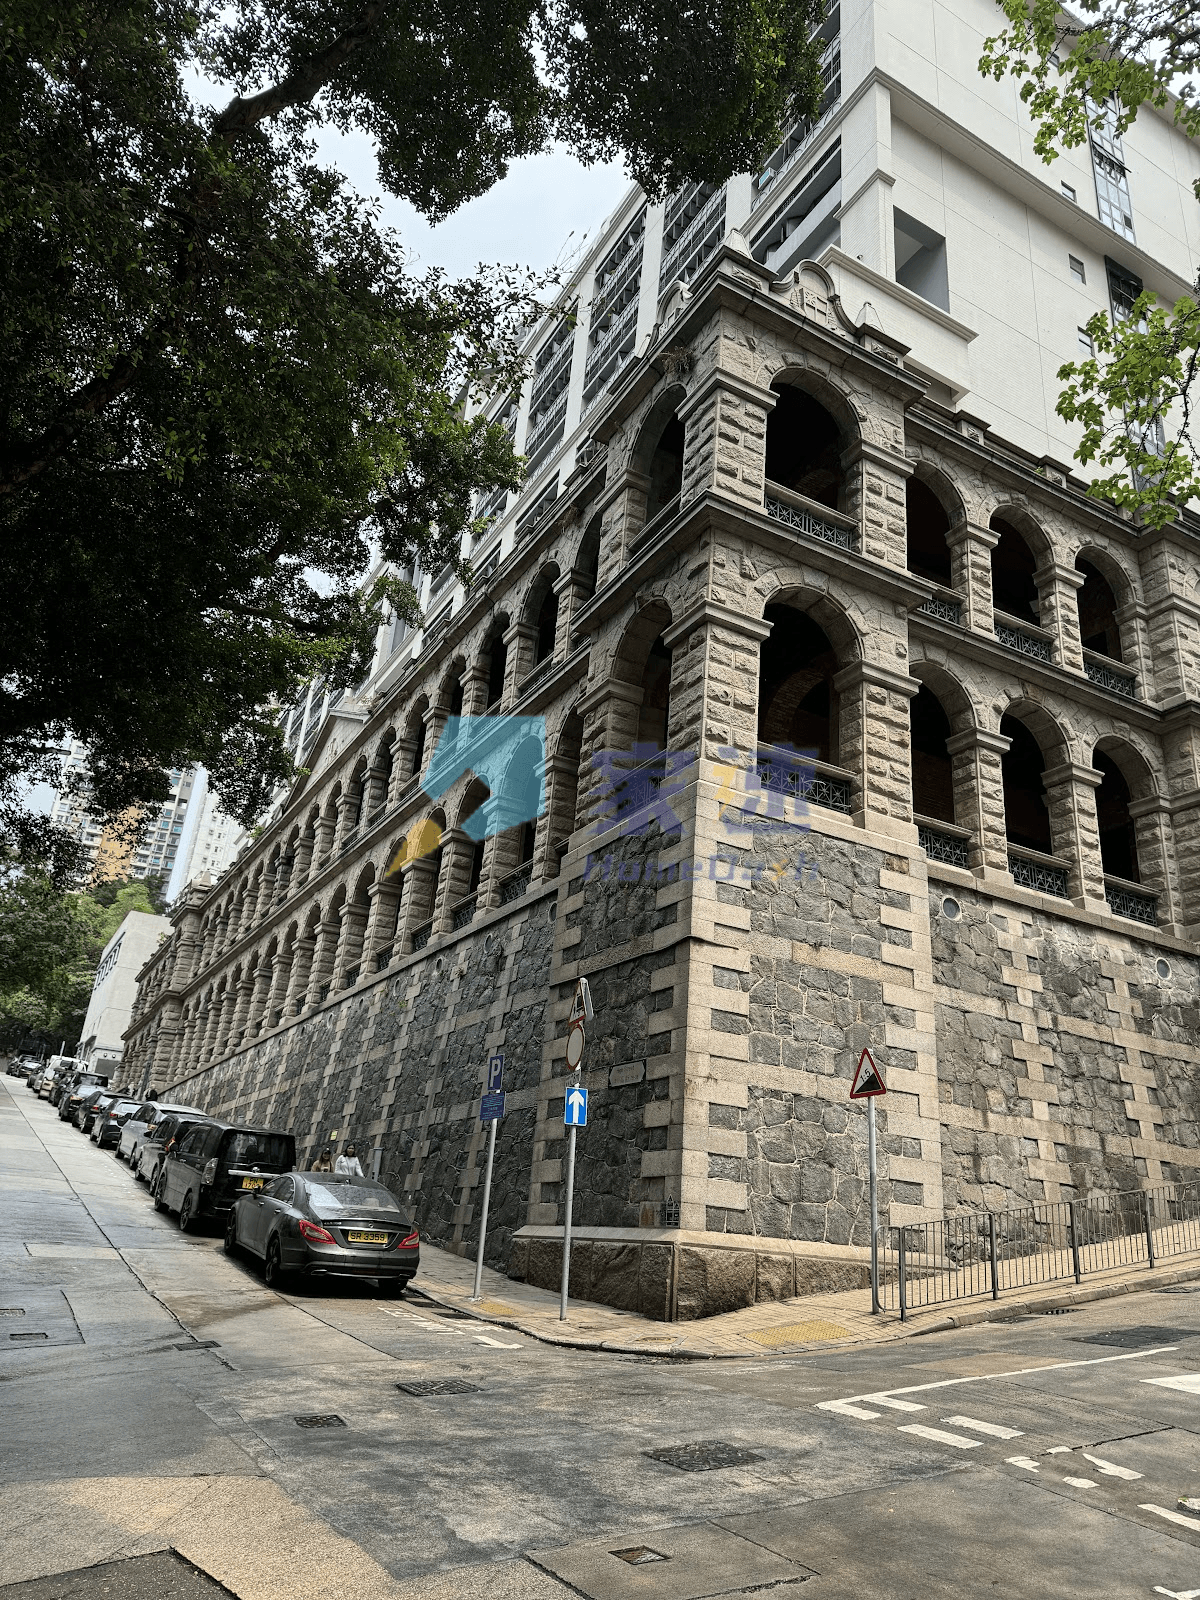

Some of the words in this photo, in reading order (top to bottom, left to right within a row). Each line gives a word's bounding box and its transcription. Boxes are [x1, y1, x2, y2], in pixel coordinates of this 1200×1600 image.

[490, 1058, 501, 1088] P
[860, 1068, 871, 1083] 1:5
[350, 1232, 362, 1240] SR
[363, 1233, 385, 1241] 3359
